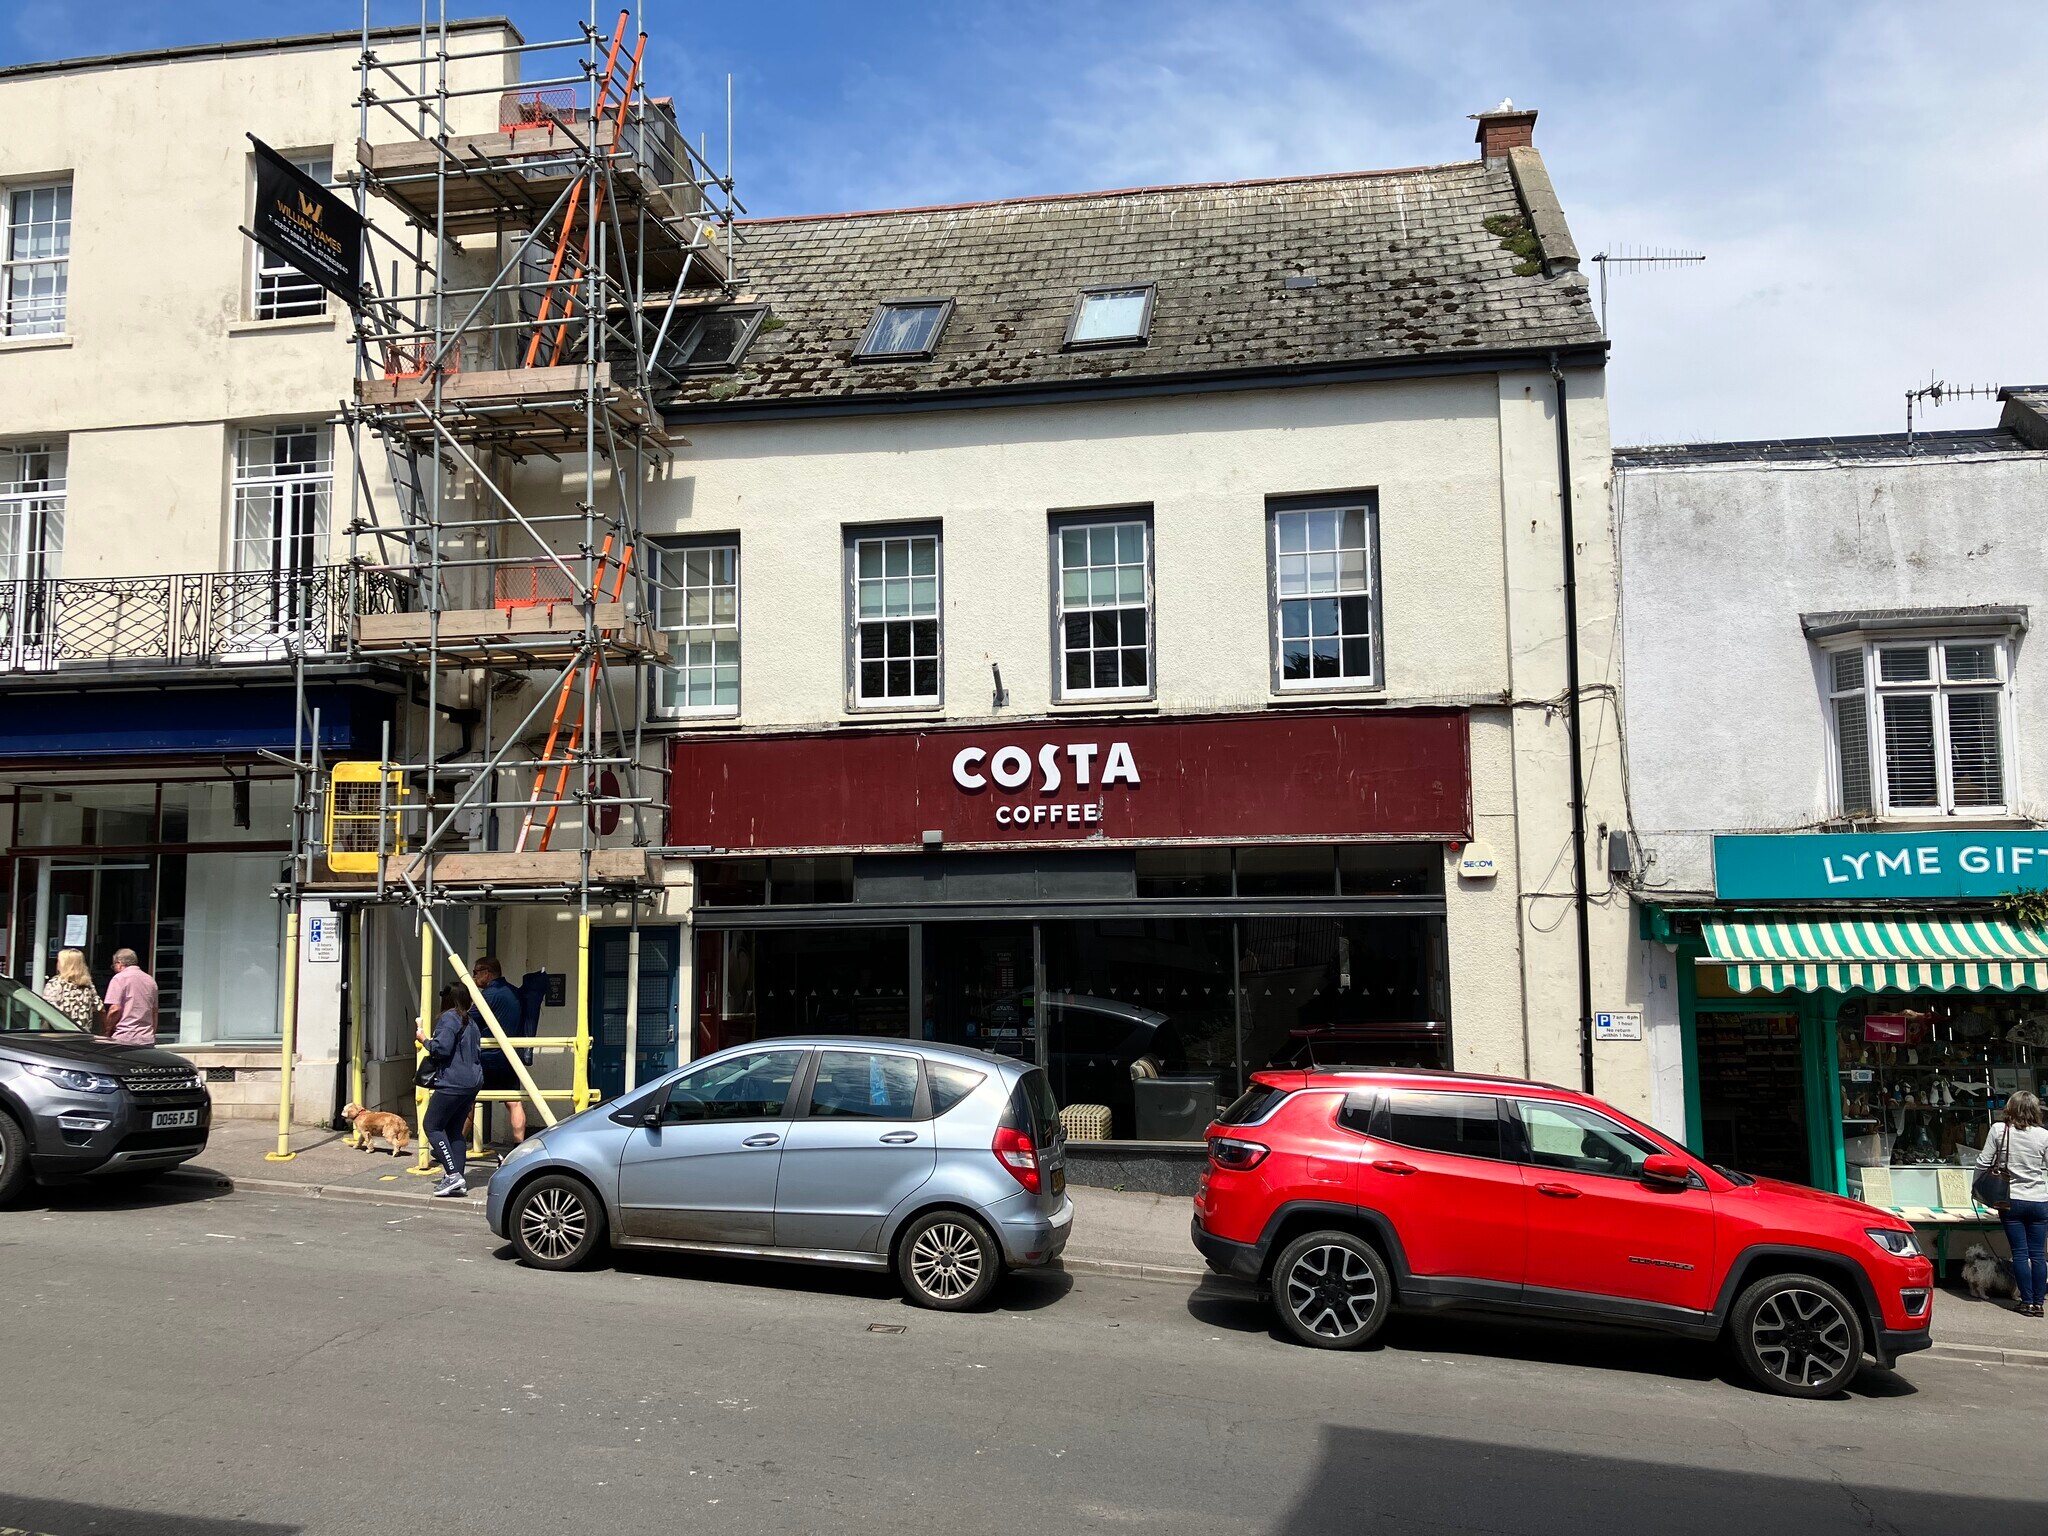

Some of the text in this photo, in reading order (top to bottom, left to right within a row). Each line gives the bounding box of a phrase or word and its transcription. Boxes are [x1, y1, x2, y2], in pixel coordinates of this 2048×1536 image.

[276, 199, 342, 254] WILLIAM JAMES
[282, 216, 336, 257] SCAFFOLDING
[952, 742, 1141, 791] COSTA
[995, 803, 1099, 824] COFFEE
[1463, 860, 1493, 868] SECOM
[1822, 846, 2048, 885] LYME GIF
[652, 1051, 665, 1061] 47
[179, 1111, 195, 1125] PJS
[438, 1140, 455, 1170] GYMKING
